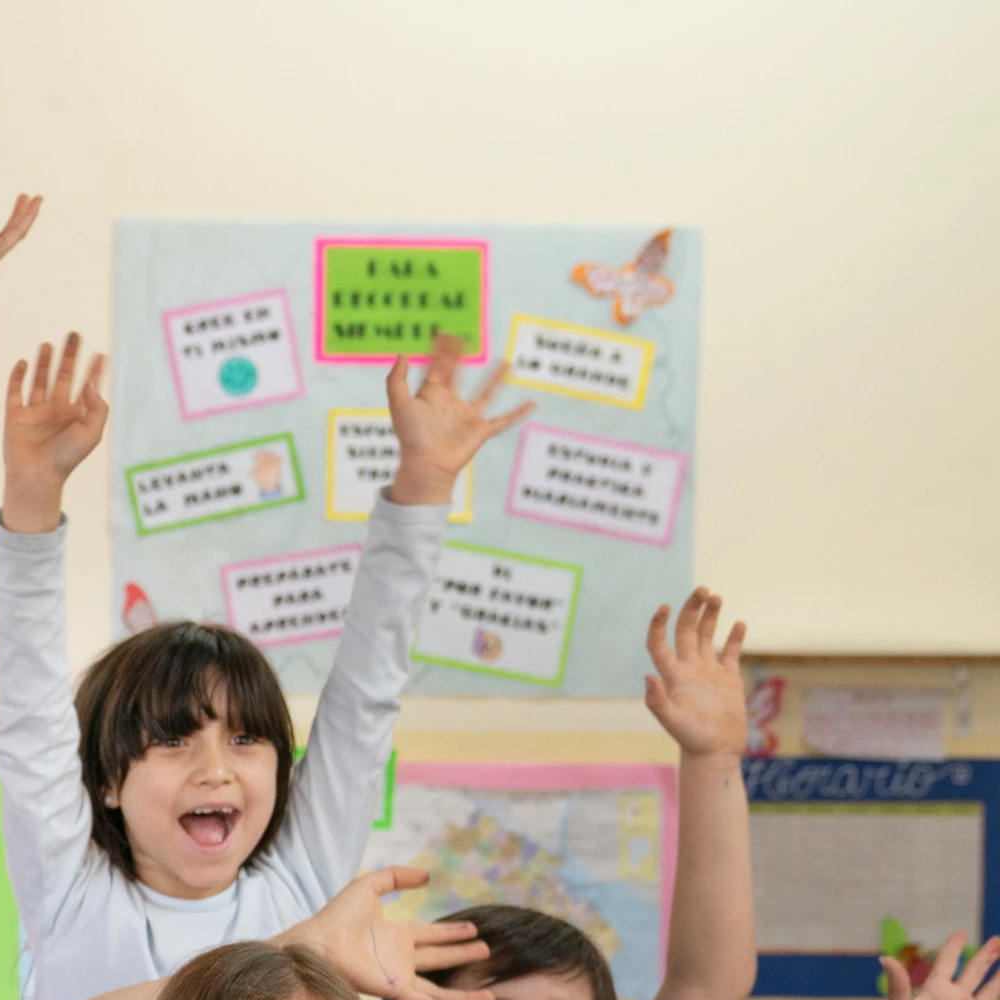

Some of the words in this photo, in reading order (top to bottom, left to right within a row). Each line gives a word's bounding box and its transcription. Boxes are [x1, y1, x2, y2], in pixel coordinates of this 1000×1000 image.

[138, 462, 230, 494] LEVANTA
[142, 500, 169, 517] LA
[183, 483, 243, 507] MANO
[272, 588, 324, 608] PARA
